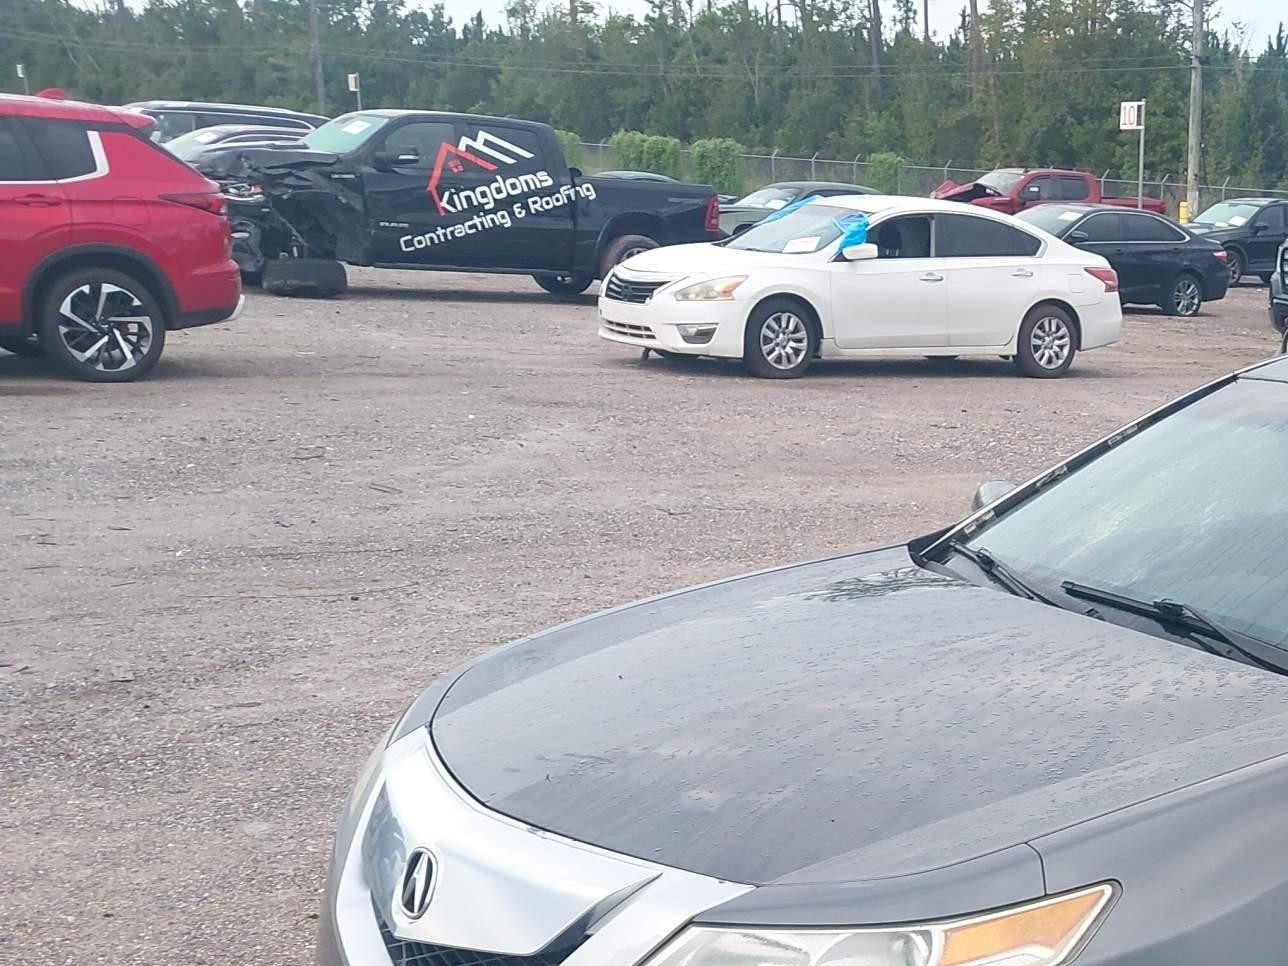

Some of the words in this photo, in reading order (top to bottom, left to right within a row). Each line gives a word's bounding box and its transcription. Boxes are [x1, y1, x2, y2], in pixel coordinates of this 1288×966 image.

[1122, 105, 1136, 126] 10
[438, 170, 554, 214] Kingdoms
[400, 211, 512, 252] Contracting
[513, 203, 526, 219] &
[527, 182, 597, 215] Roofing
